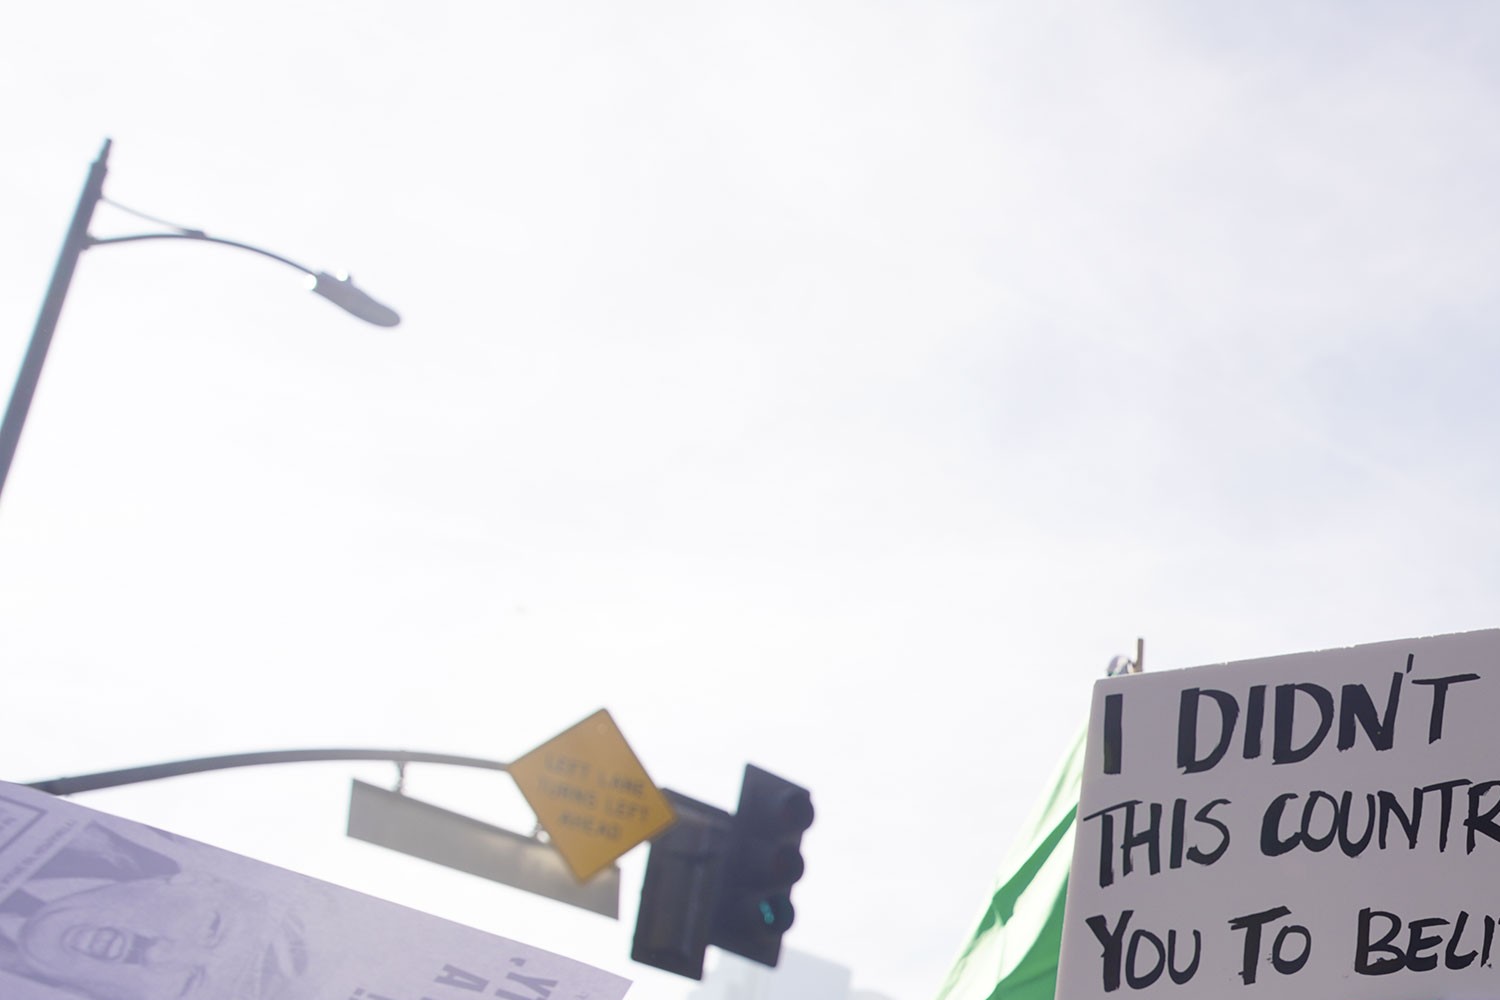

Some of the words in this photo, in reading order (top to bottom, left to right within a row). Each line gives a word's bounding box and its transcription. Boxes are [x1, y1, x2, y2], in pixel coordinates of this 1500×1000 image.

[1104, 694, 1122, 774] I
[1177, 654, 1480, 774] DIDN'T
[1083, 799, 1231, 888] THIS
[1085, 910, 1201, 992] YOU
[1228, 906, 1311, 985] TO
